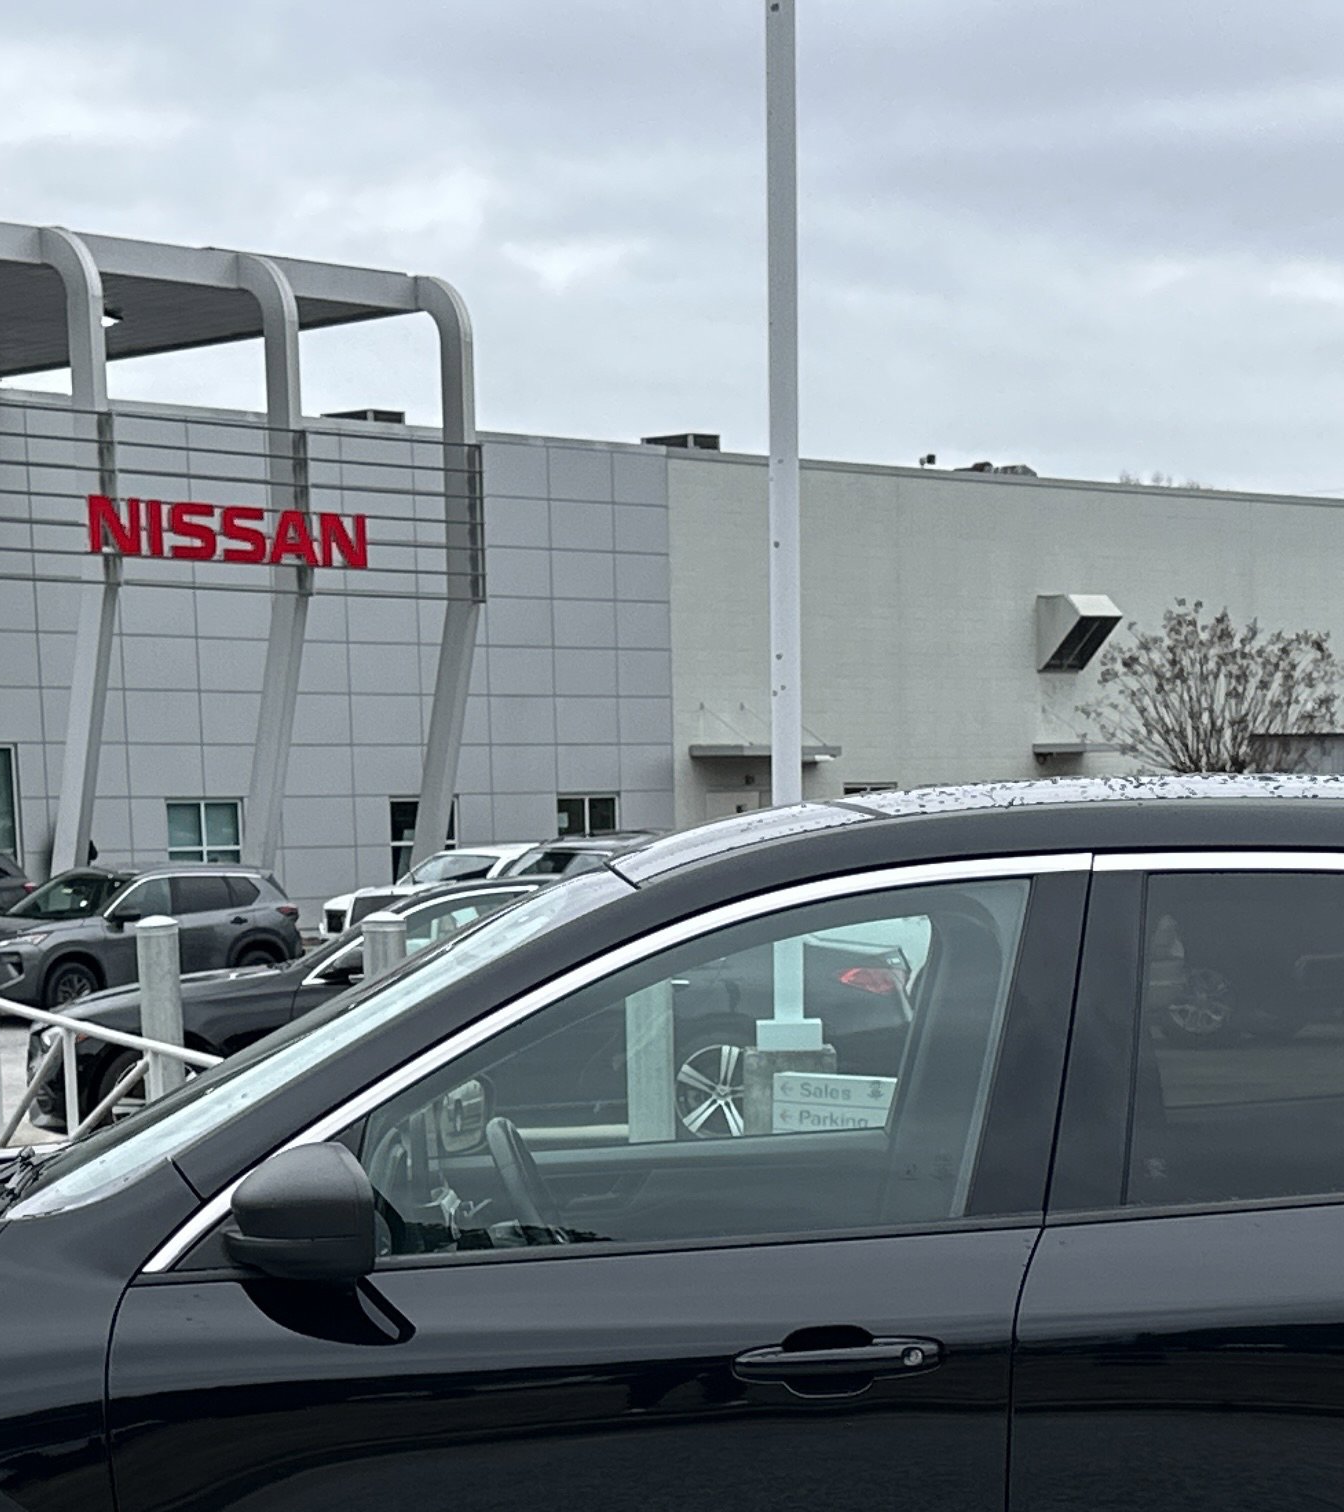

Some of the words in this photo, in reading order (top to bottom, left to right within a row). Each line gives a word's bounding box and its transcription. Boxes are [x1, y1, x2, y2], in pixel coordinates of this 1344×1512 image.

[87, 495, 368, 569] NISSAN
[799, 1083, 852, 1100] Sales
[799, 1110, 869, 1128] Parking
